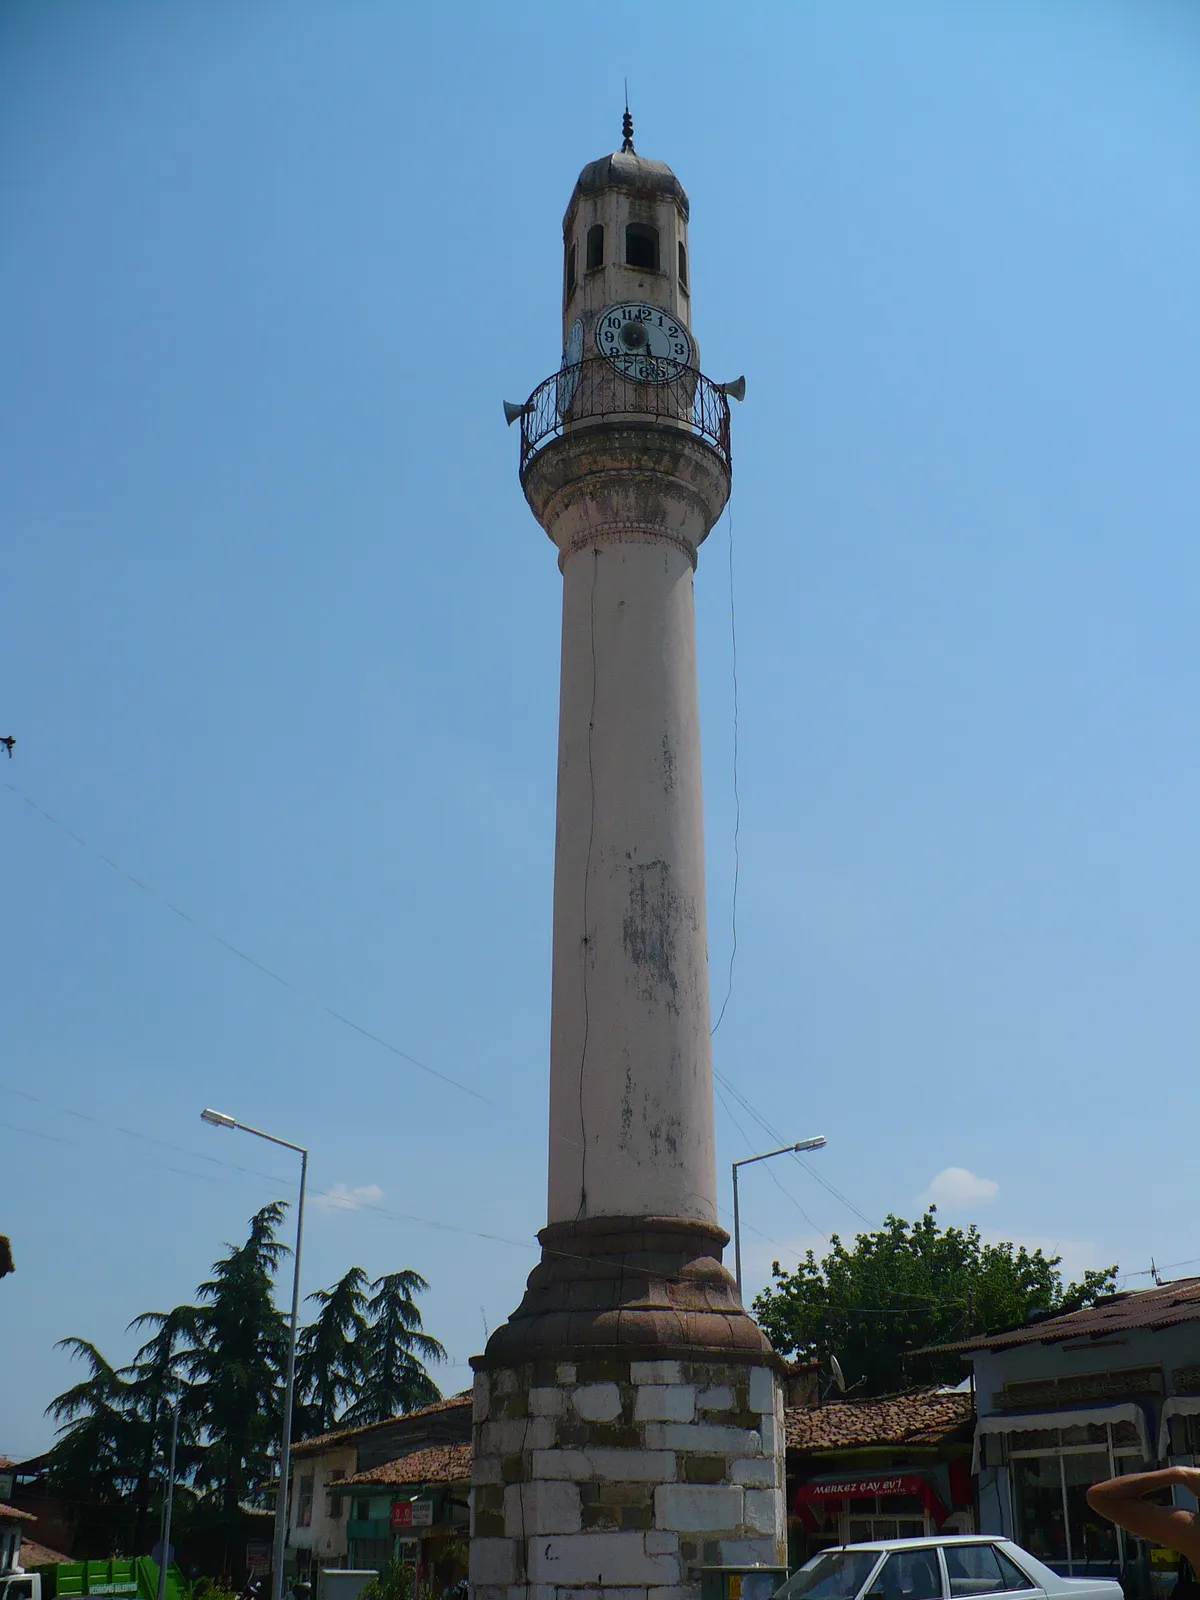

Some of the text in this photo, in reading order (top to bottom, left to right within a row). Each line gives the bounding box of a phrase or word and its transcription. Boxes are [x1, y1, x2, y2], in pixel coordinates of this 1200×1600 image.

[622, 308, 632, 320] 11
[637, 308, 652, 321] 12
[607, 316, 621, 329] 10
[658, 316, 664, 327] 1
[605, 331, 614, 343] 9
[668, 326, 678, 338] 2
[674, 343, 684, 354] 3
[639, 366, 650, 378] 6
[813, 1483, 856, 1494] MERKEZ
[859, 1481, 880, 1492] ÇAY
